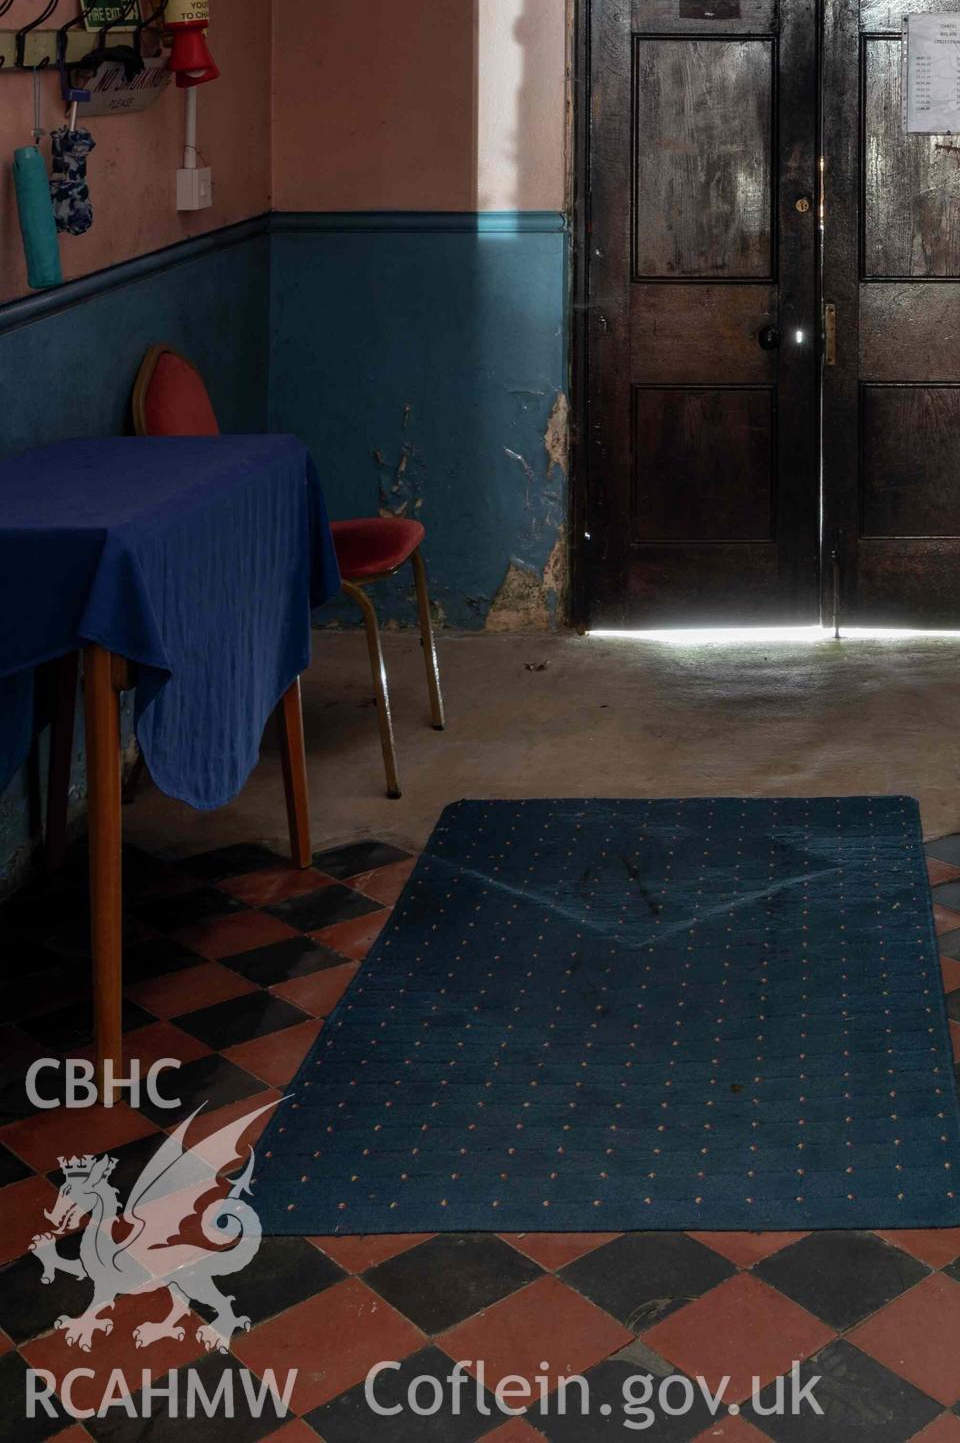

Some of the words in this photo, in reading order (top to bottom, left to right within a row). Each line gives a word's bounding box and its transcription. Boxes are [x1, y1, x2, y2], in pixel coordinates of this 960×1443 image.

[88, 7, 105, 22] FIRE
[105, 7, 121, 21] EXIT
[180, 12, 194, 20] TO
[93, 68, 120, 93] NO
